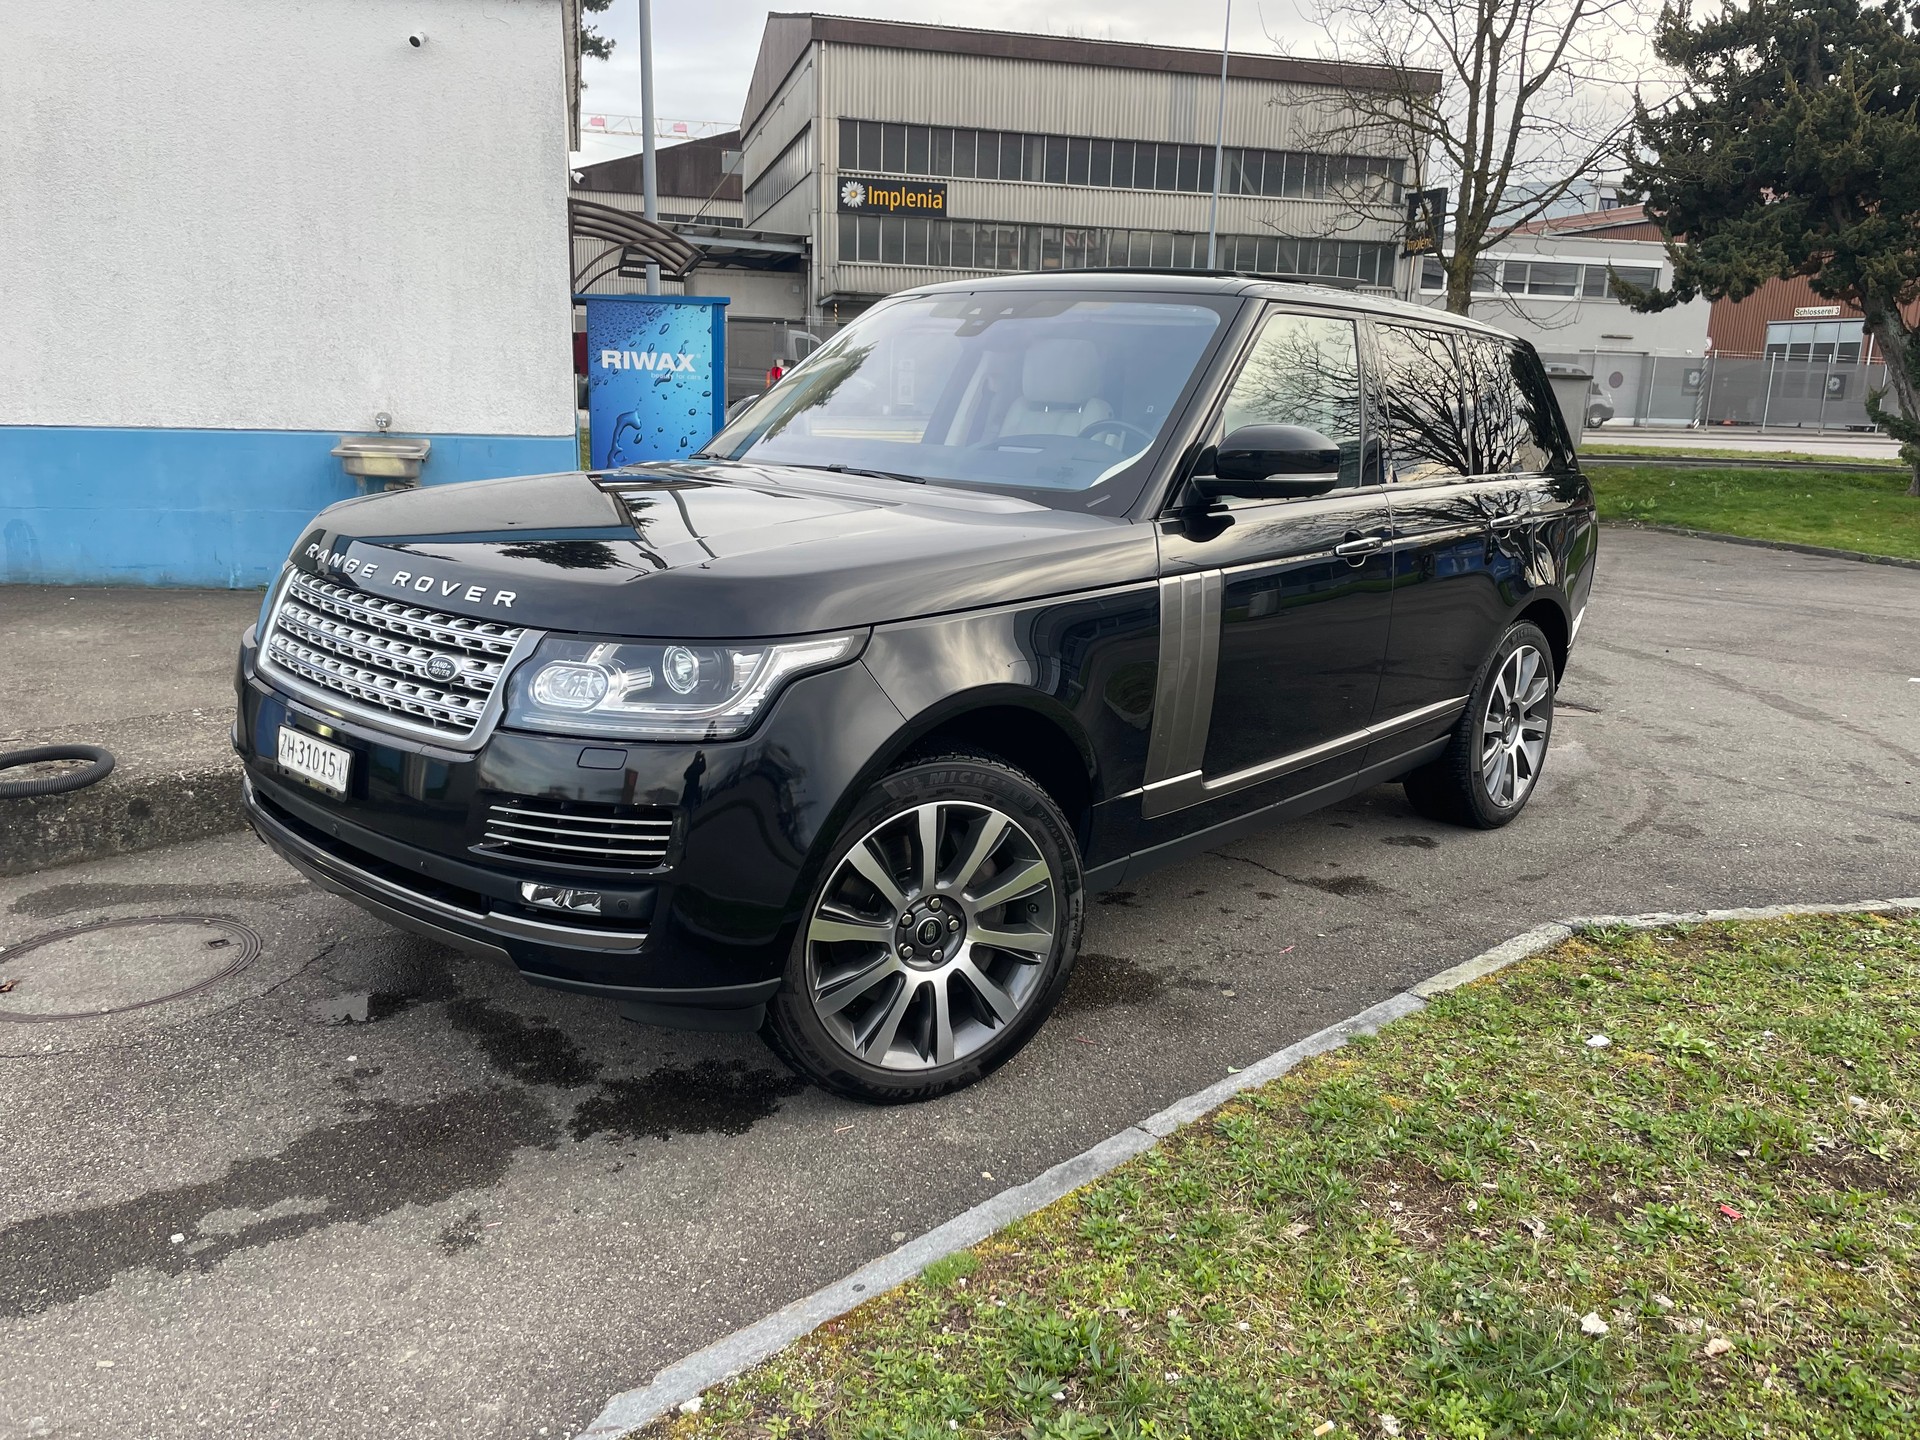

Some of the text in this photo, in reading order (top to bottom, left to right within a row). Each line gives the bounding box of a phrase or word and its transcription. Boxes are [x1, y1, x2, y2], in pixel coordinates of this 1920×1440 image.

[868, 185, 943, 212] Implenia
[1795, 307, 1840, 316] Schlosserei 3
[601, 350, 696, 372] RIWAX
[305, 543, 517, 607] RANGE ROVER
[431, 660, 448, 669] LAND
[431, 668, 451, 677] ROVER
